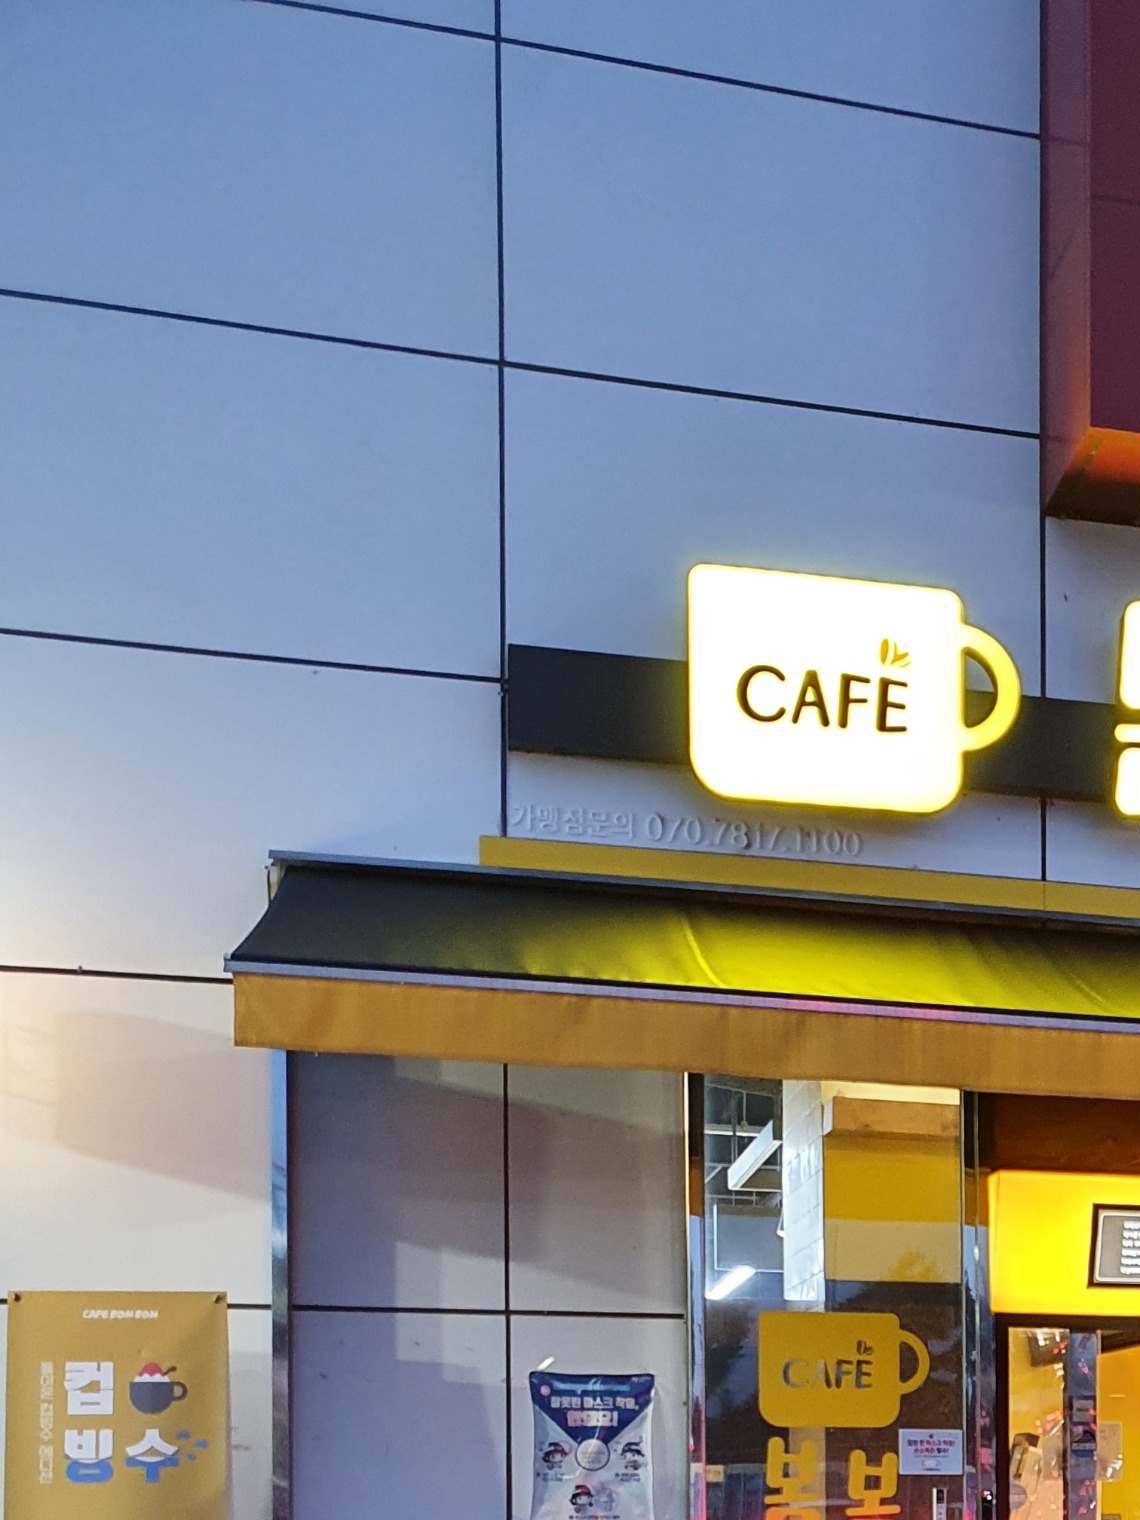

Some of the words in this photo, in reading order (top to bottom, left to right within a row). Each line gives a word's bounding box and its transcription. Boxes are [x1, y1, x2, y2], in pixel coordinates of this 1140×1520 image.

[737, 664, 909, 733] CAFE
[512, 803, 635, 839] 가맹점문의
[782, 1359, 874, 1390] CAFE
